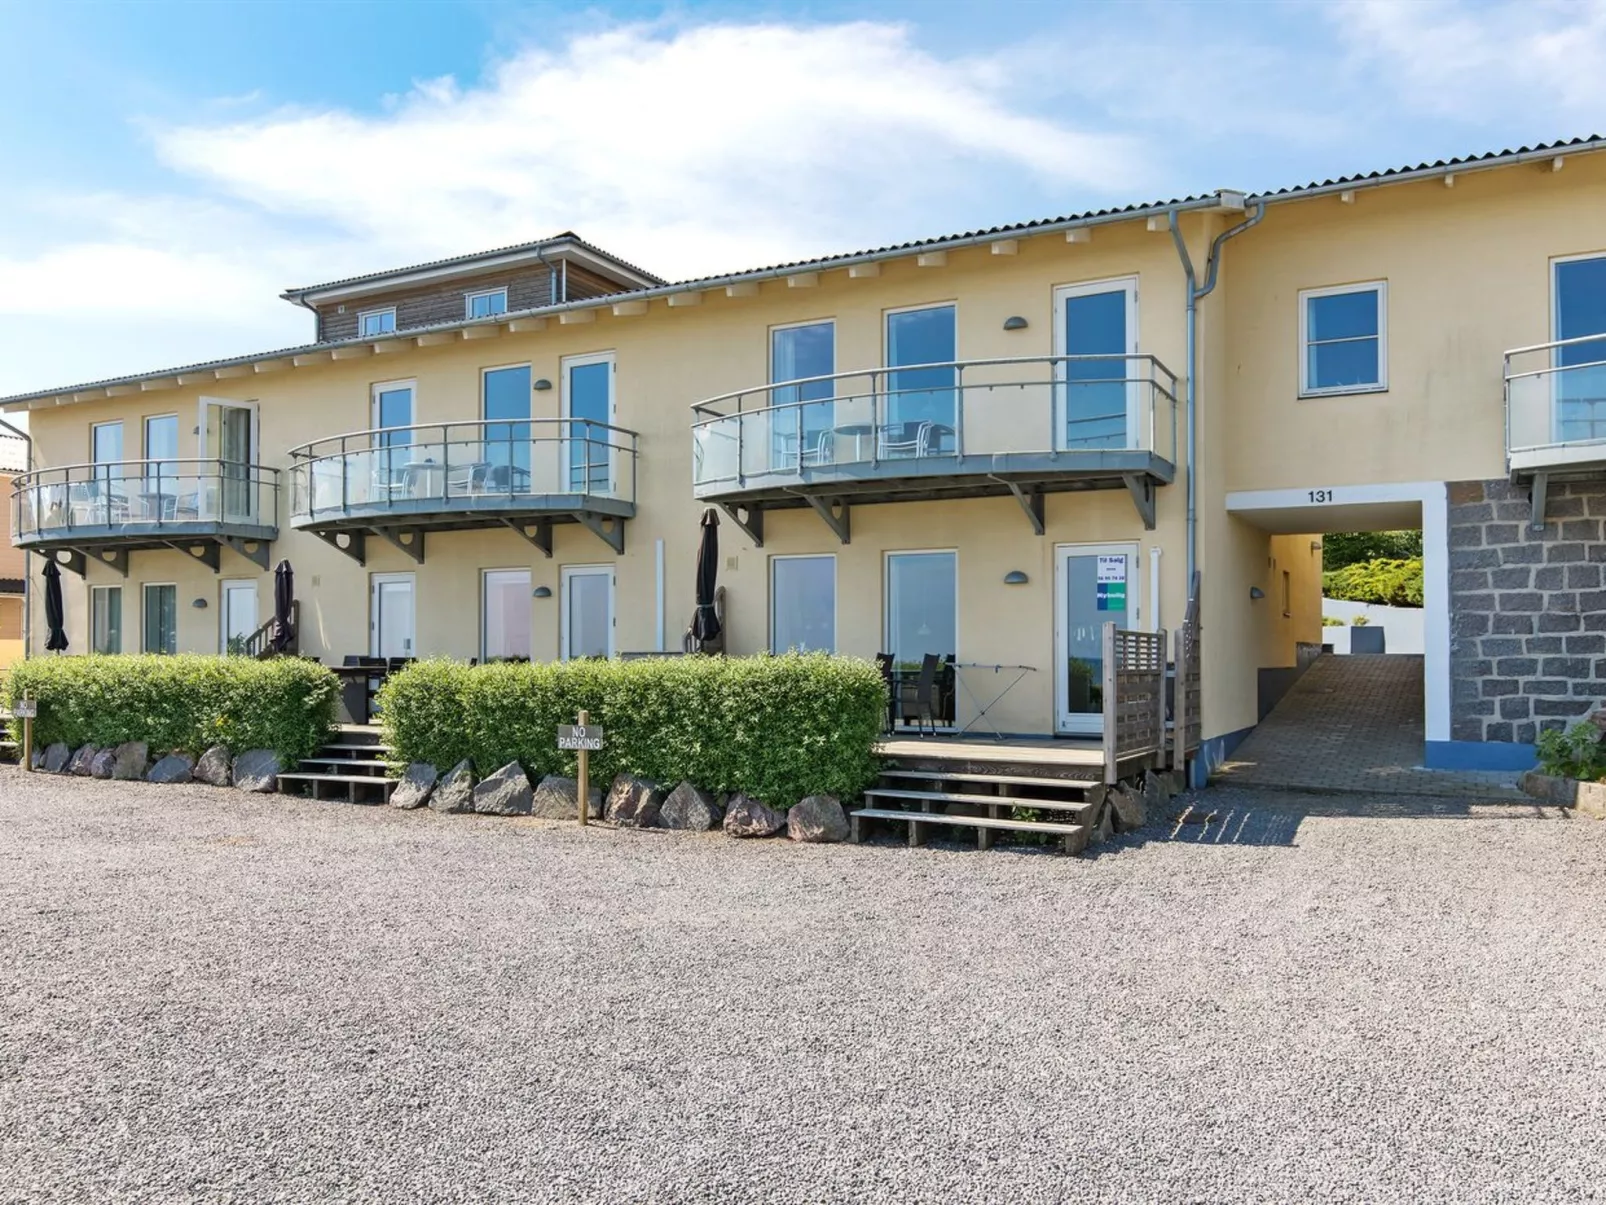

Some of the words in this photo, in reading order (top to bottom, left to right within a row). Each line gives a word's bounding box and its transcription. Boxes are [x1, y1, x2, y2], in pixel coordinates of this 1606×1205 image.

[1308, 490, 1333, 503] 131
[572, 726, 586, 738] NO
[559, 737, 600, 749] PARKING
